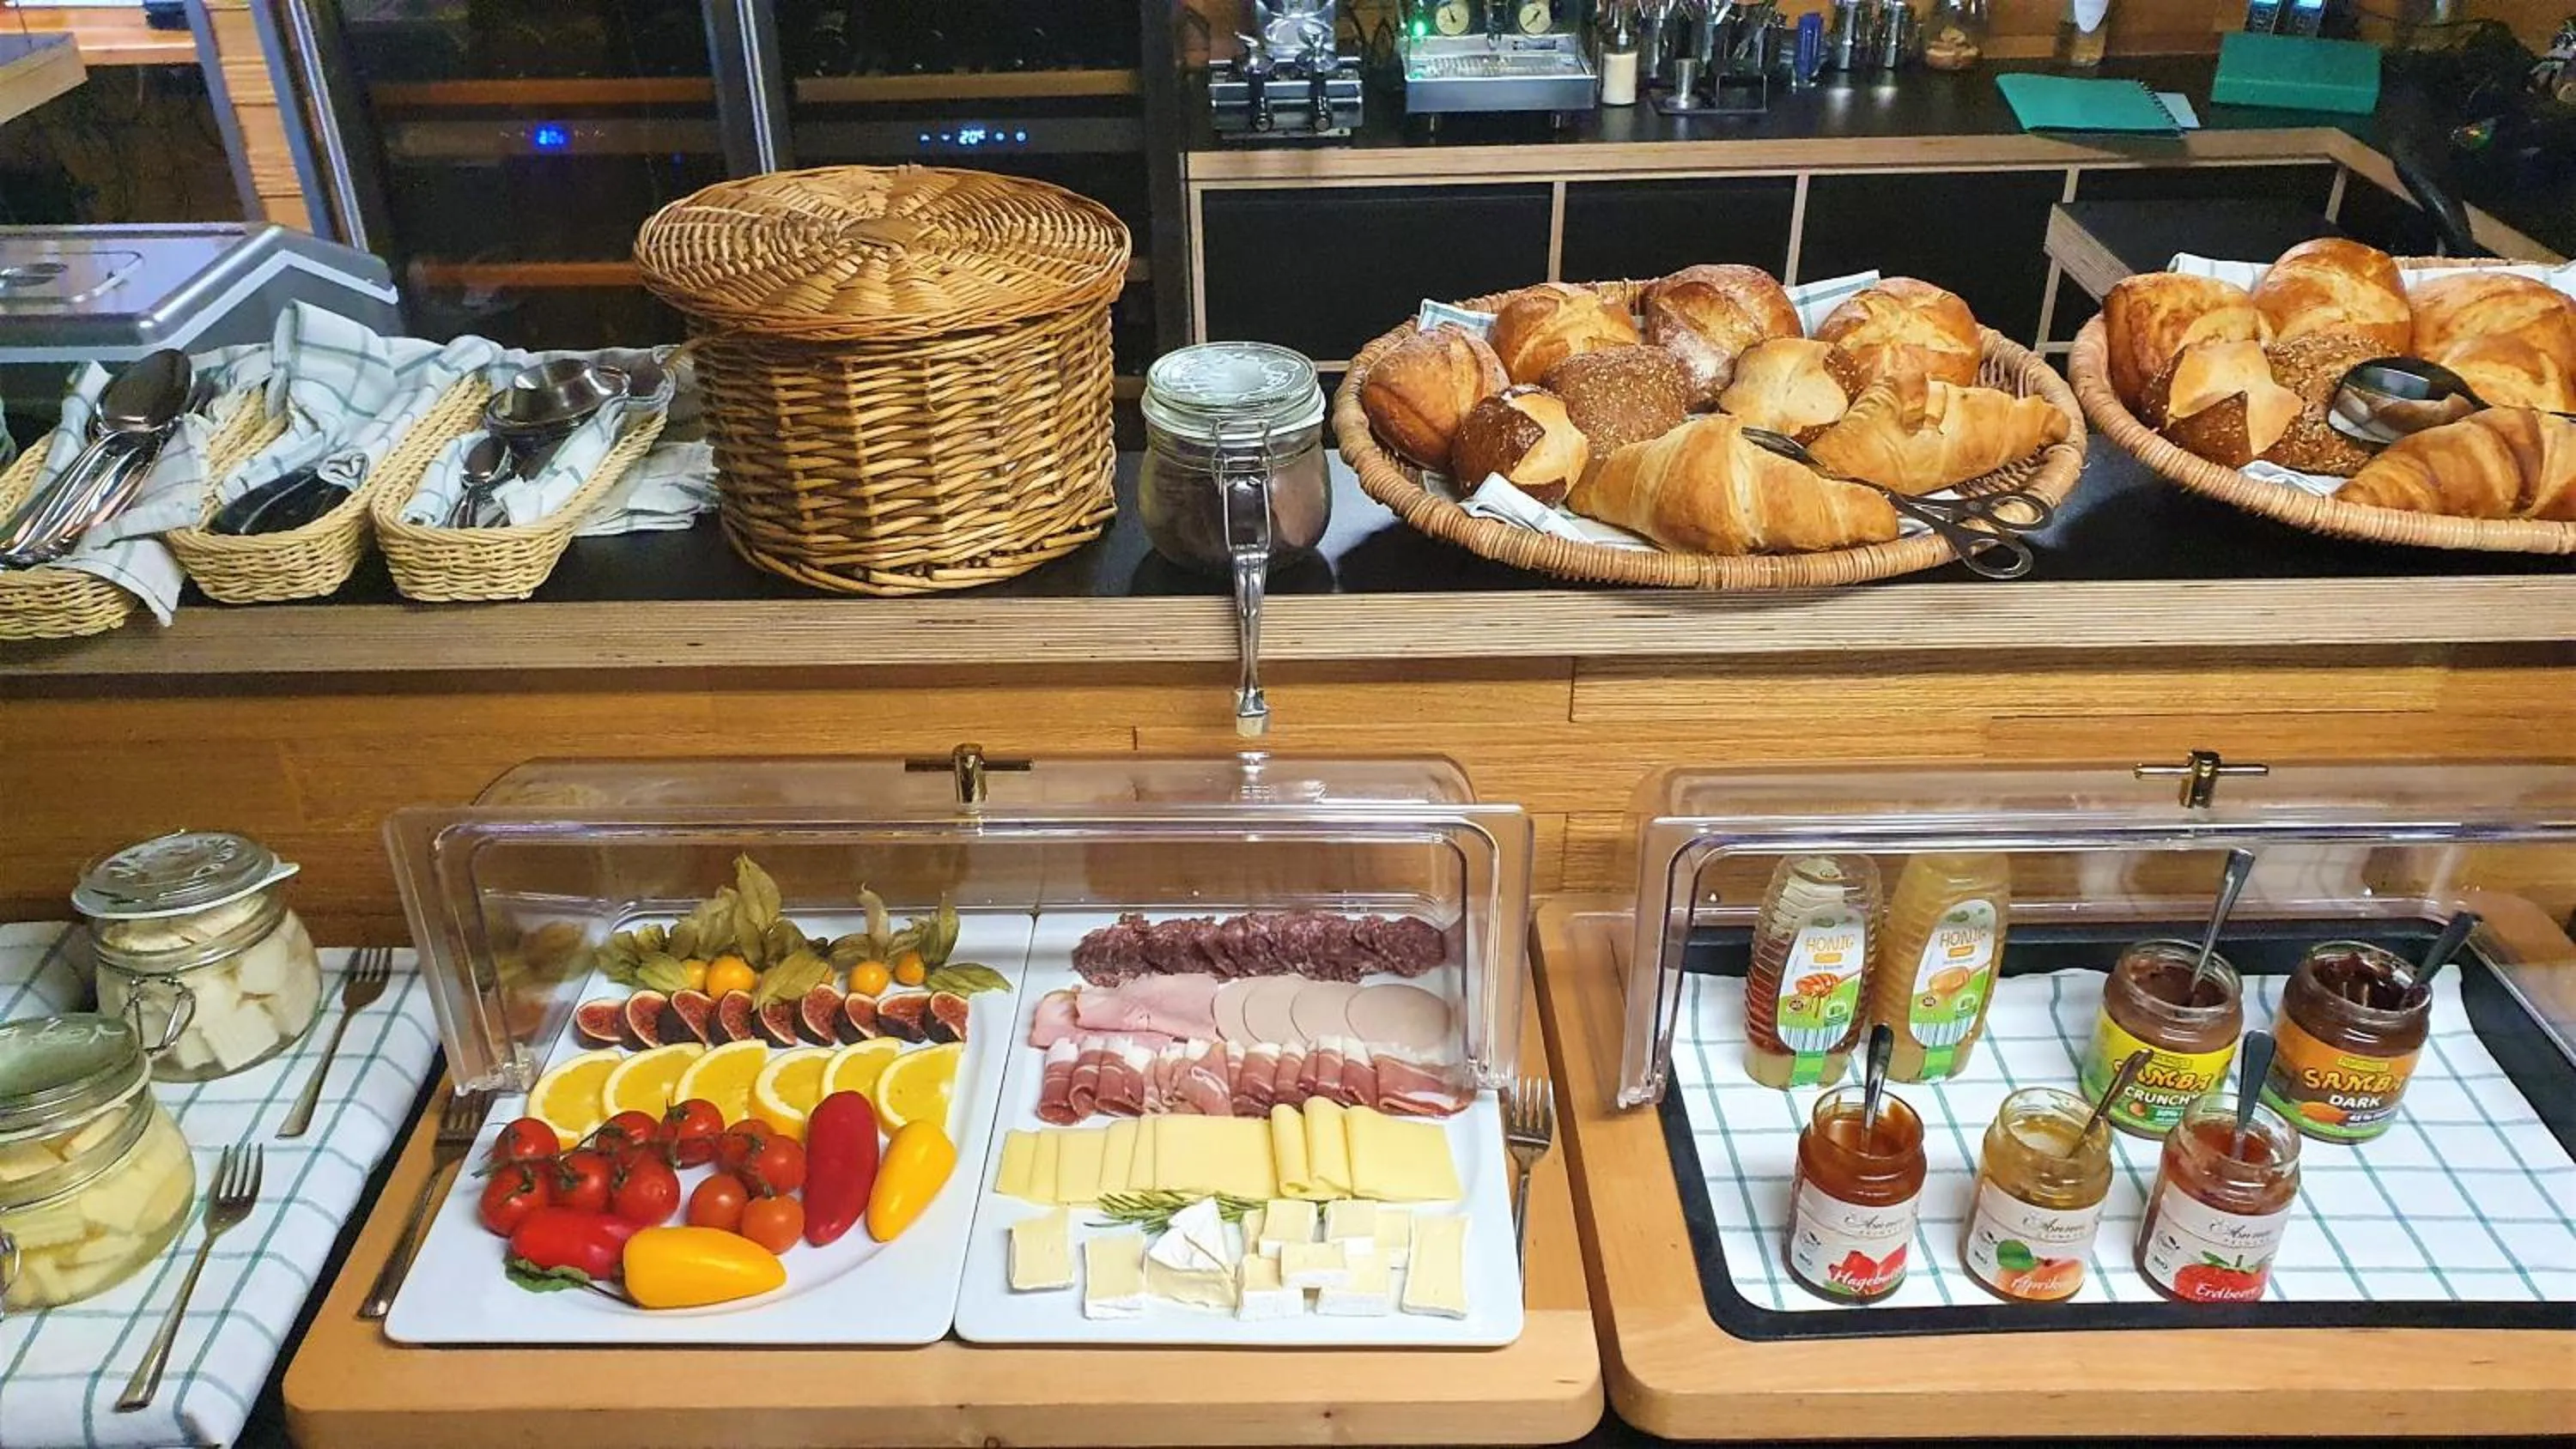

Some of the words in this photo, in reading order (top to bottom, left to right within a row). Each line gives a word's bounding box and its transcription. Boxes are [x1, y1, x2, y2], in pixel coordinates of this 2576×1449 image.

[1806, 933, 1855, 953] HONIG
[2112, 1059, 2213, 1091] SMBA
[2303, 1067, 2404, 1093] SAMBA
[2329, 1094, 2383, 1108] DARK
[1832, 1267, 1905, 1292] Hagebu
[2011, 1273, 2071, 1294] Aprik
